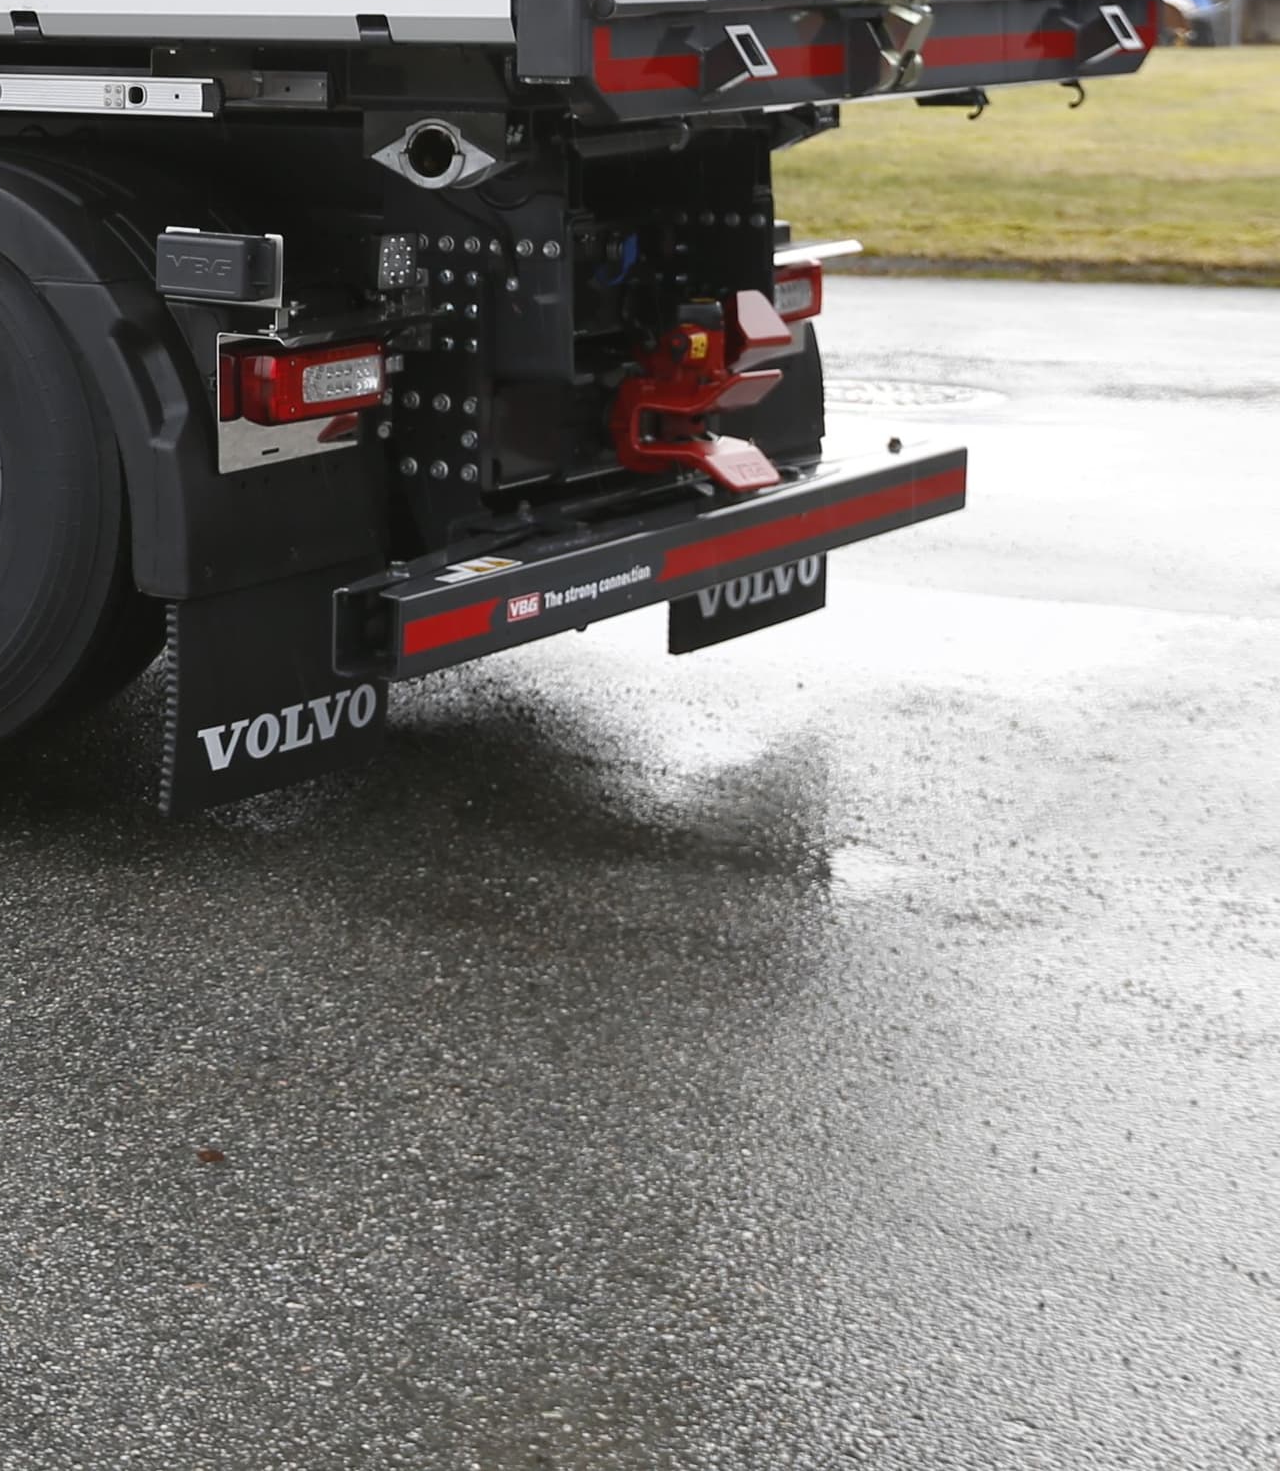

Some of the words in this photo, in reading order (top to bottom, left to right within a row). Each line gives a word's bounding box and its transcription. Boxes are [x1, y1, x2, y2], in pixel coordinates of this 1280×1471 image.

[165, 254, 233, 277] VBG
[509, 597, 539, 618] VBG
[544, 591, 563, 610] The
[565, 582, 598, 604] strong
[599, 564, 652, 593] connection
[696, 554, 821, 619] VOLVO
[197, 684, 377, 772] VOLVO
